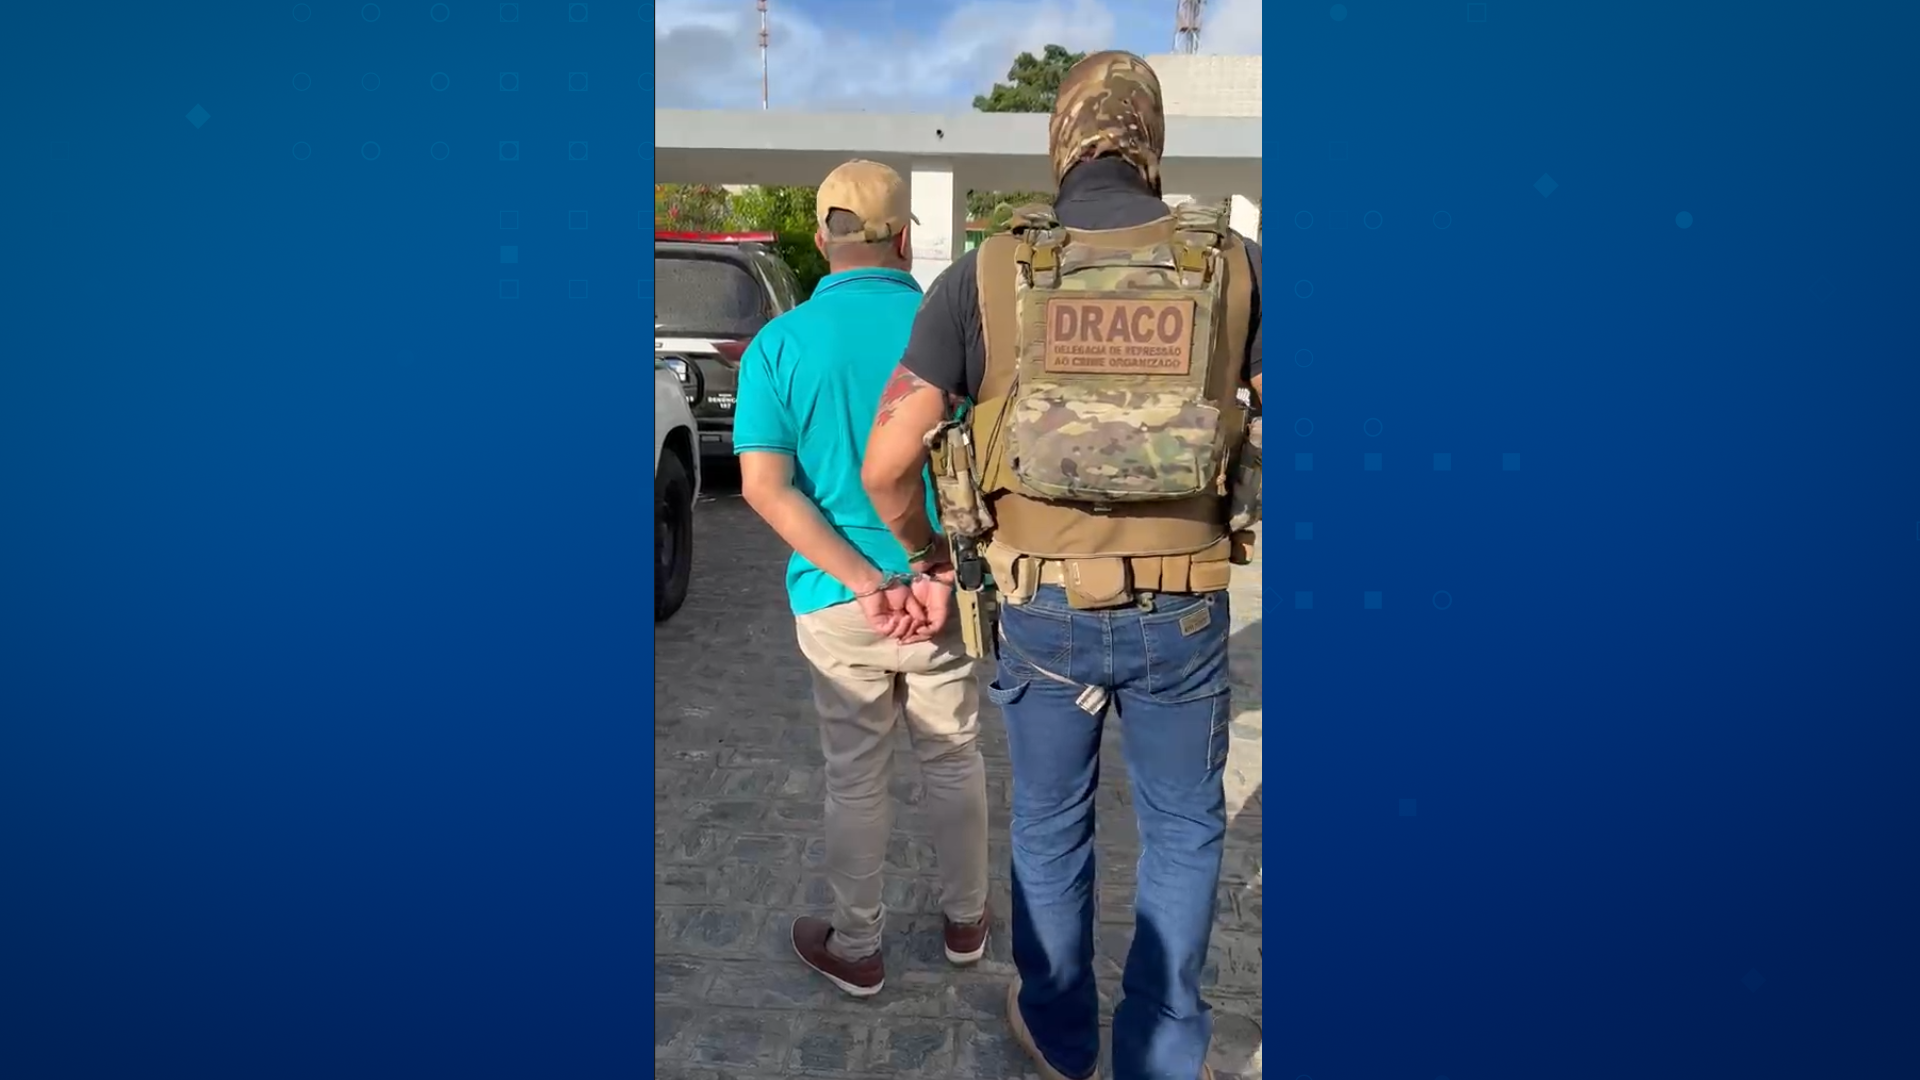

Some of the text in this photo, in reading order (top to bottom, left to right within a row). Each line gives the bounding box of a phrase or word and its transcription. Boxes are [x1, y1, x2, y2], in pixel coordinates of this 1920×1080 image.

[1054, 305, 1184, 344] DRACO
[1054, 345, 1182, 356] DELEGACIA DE REPRESSÃO
[1054, 357, 1181, 368] AO CRIME ORGANIZADO
